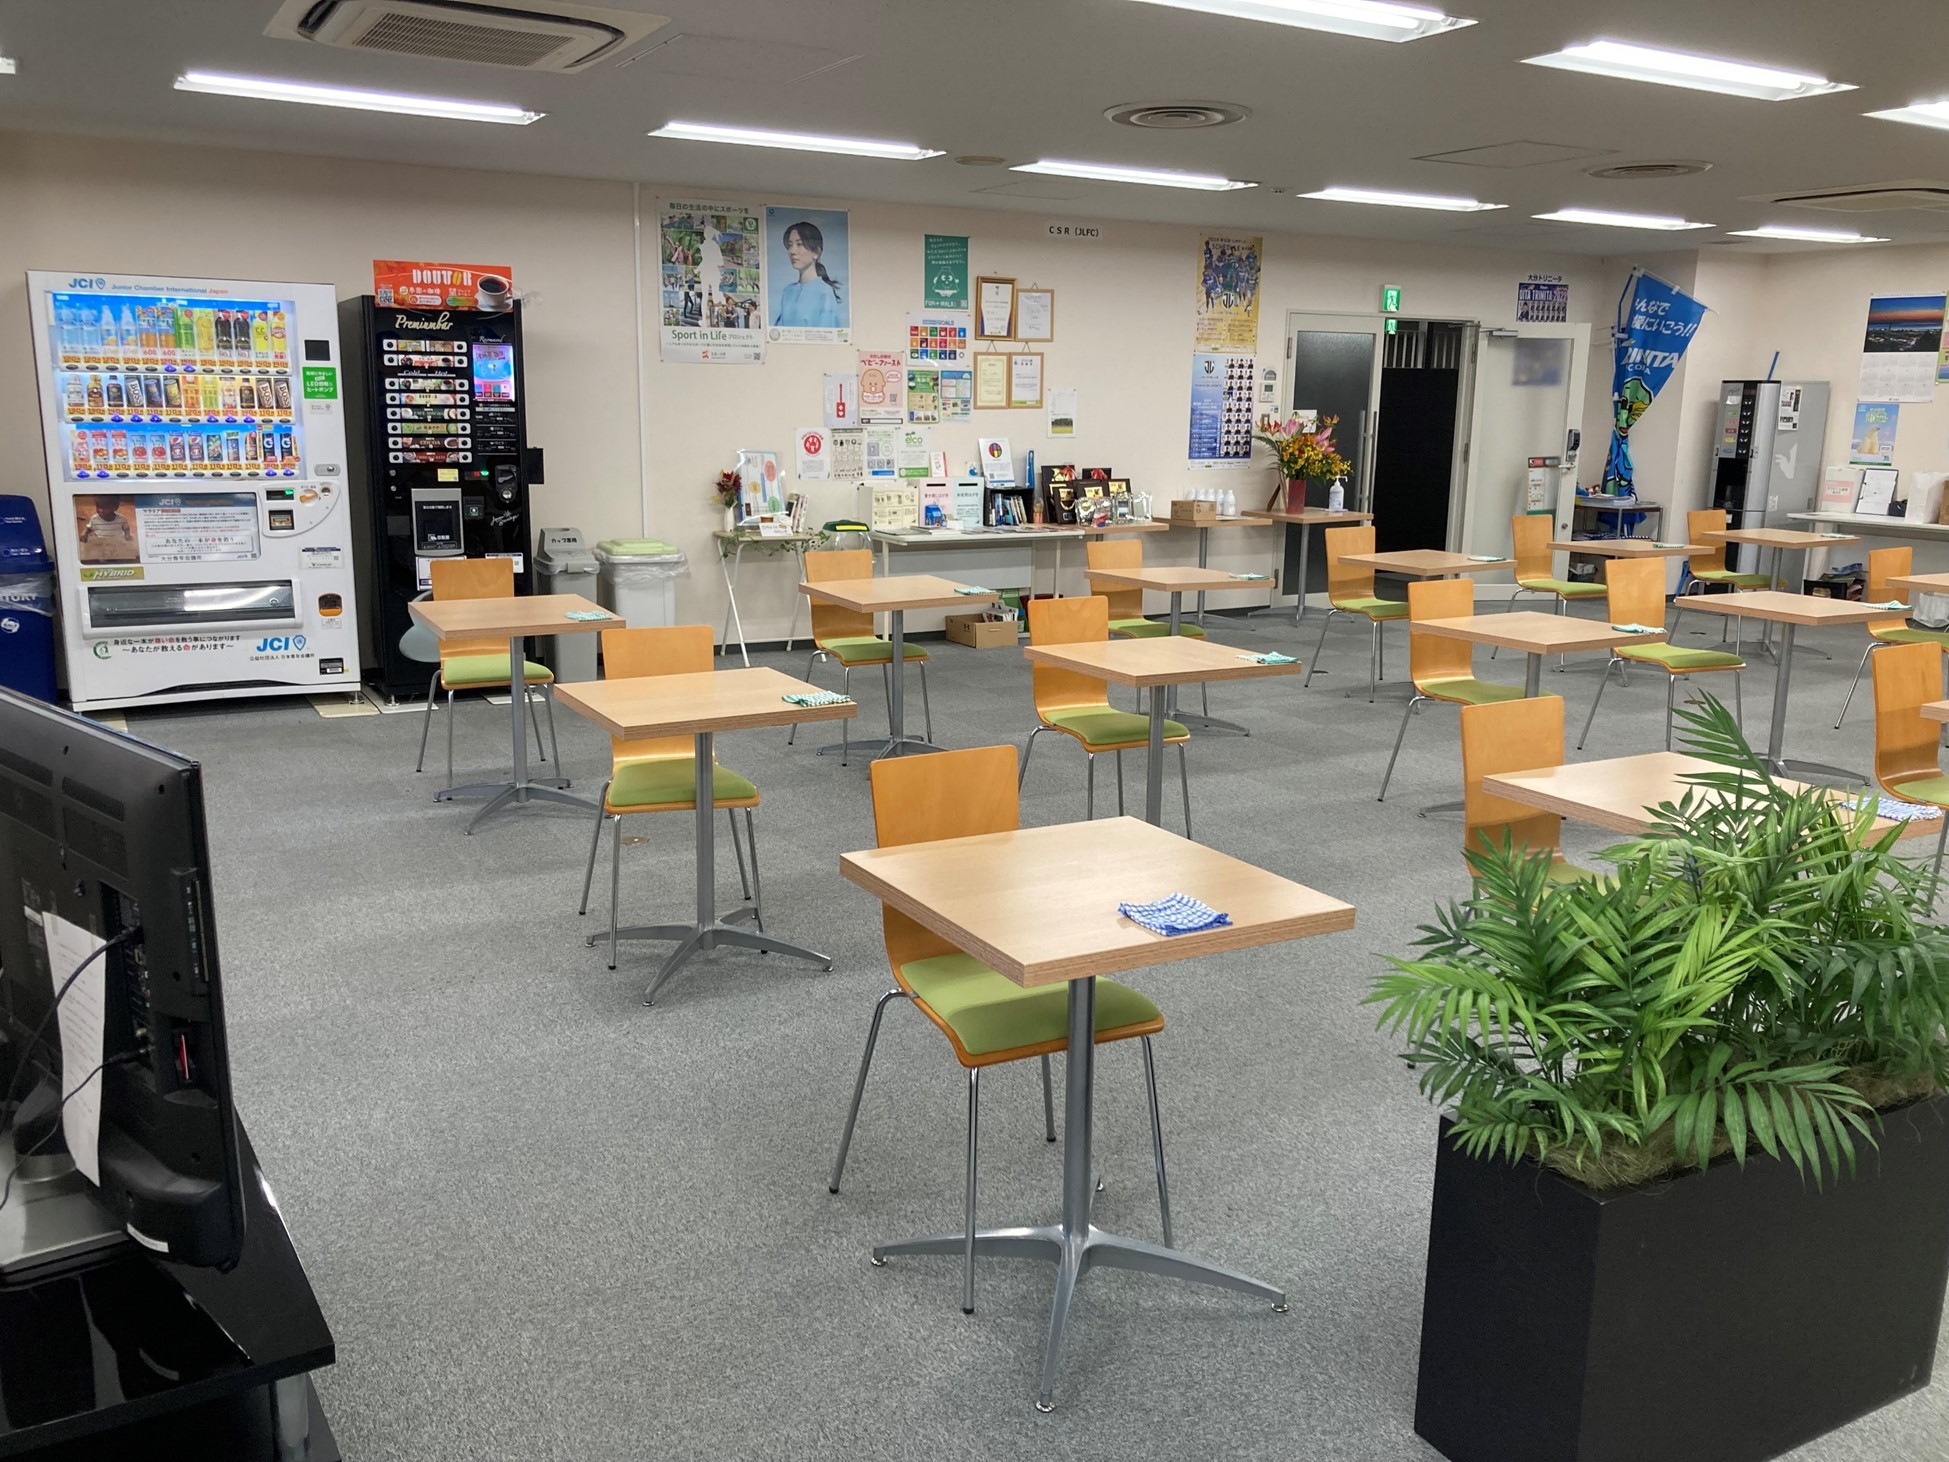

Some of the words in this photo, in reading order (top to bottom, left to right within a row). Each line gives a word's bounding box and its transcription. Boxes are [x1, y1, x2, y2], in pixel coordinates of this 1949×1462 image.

[669, 202, 749, 214] 毎日の生活の中にスポーツを
[412, 269, 472, 286] DOUTOR
[1528, 274, 1563, 282] 大分トリニータ
[69, 278, 93, 289] JCI
[134, 284, 164, 292] Chamber
[166, 286, 207, 294] International
[671, 330, 698, 341] Sport
[699, 330, 708, 340] in
[710, 331, 727, 340] Life
[93, 569, 135, 580] HYBRID
[256, 637, 289, 652] JCI
